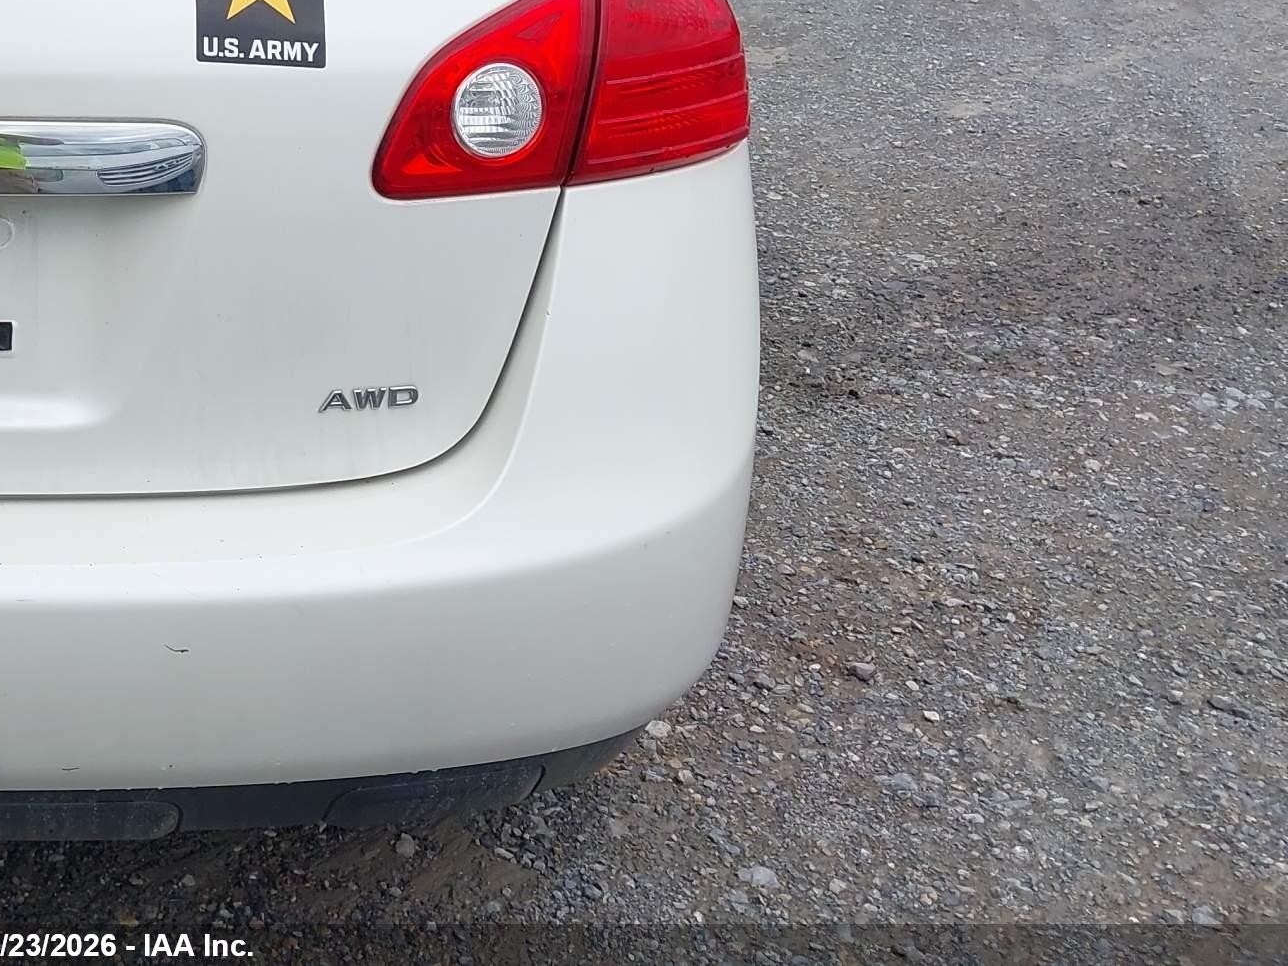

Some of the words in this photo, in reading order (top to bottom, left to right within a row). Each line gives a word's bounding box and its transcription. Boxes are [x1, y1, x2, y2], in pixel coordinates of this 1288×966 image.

[203, 36, 245, 59] U.S.
[248, 39, 319, 62] ARMY
[318, 384, 420, 413] AWD
